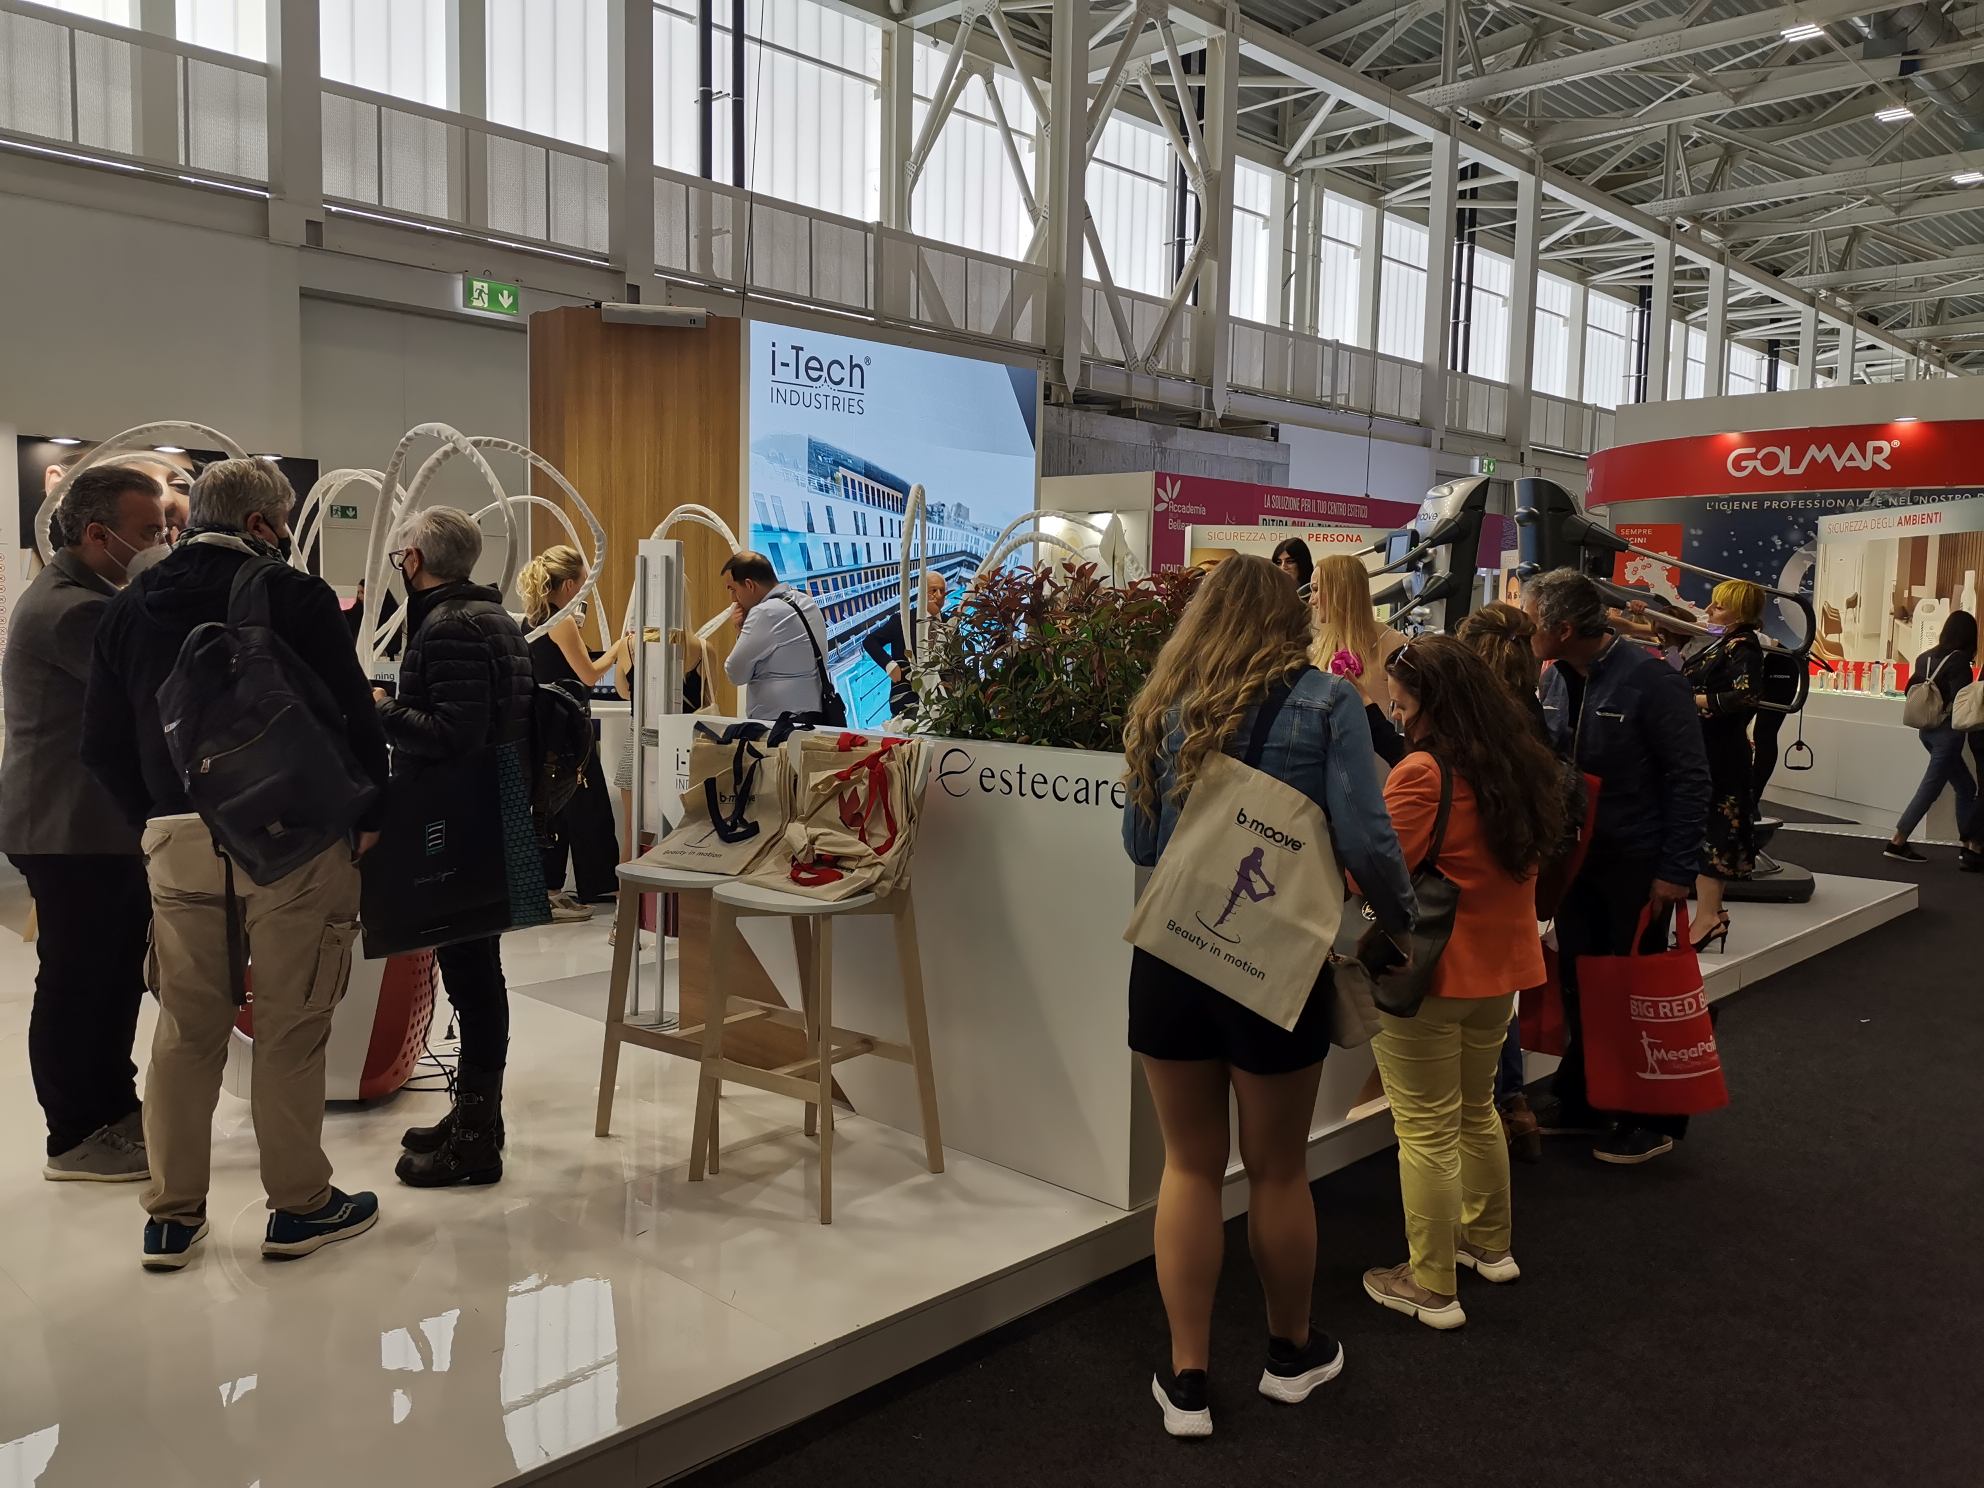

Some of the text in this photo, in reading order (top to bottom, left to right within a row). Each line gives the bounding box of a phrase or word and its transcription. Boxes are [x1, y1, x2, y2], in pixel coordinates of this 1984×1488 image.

[770, 386, 865, 415] INDUSTRIES
[1168, 500, 1206, 515] Accademia
[1264, 494, 1270, 508] LA
[1271, 495, 1300, 511] SOLUZIONE
[1300, 498, 1311, 512] PER
[1317, 500, 1327, 514] TUO
[1327, 502, 1346, 516] CENTRO
[1347, 504, 1368, 518] ESTETICO
[1764, 497, 1871, 509] PROFESSIONALE
[1888, 496, 1913, 506] NEL
[1827, 520, 1868, 534] SICUREZZA
[1897, 511, 1942, 527] AMBIENTI
[1207, 531, 1267, 541] SICUREZZA
[1307, 533, 1363, 543] PERSONA
[979, 763, 1125, 809] estecare
[1166, 919, 1266, 981] Beauty in motion
[1630, 1001, 1654, 1017] BIG
[1659, 998, 1696, 1017] RED
